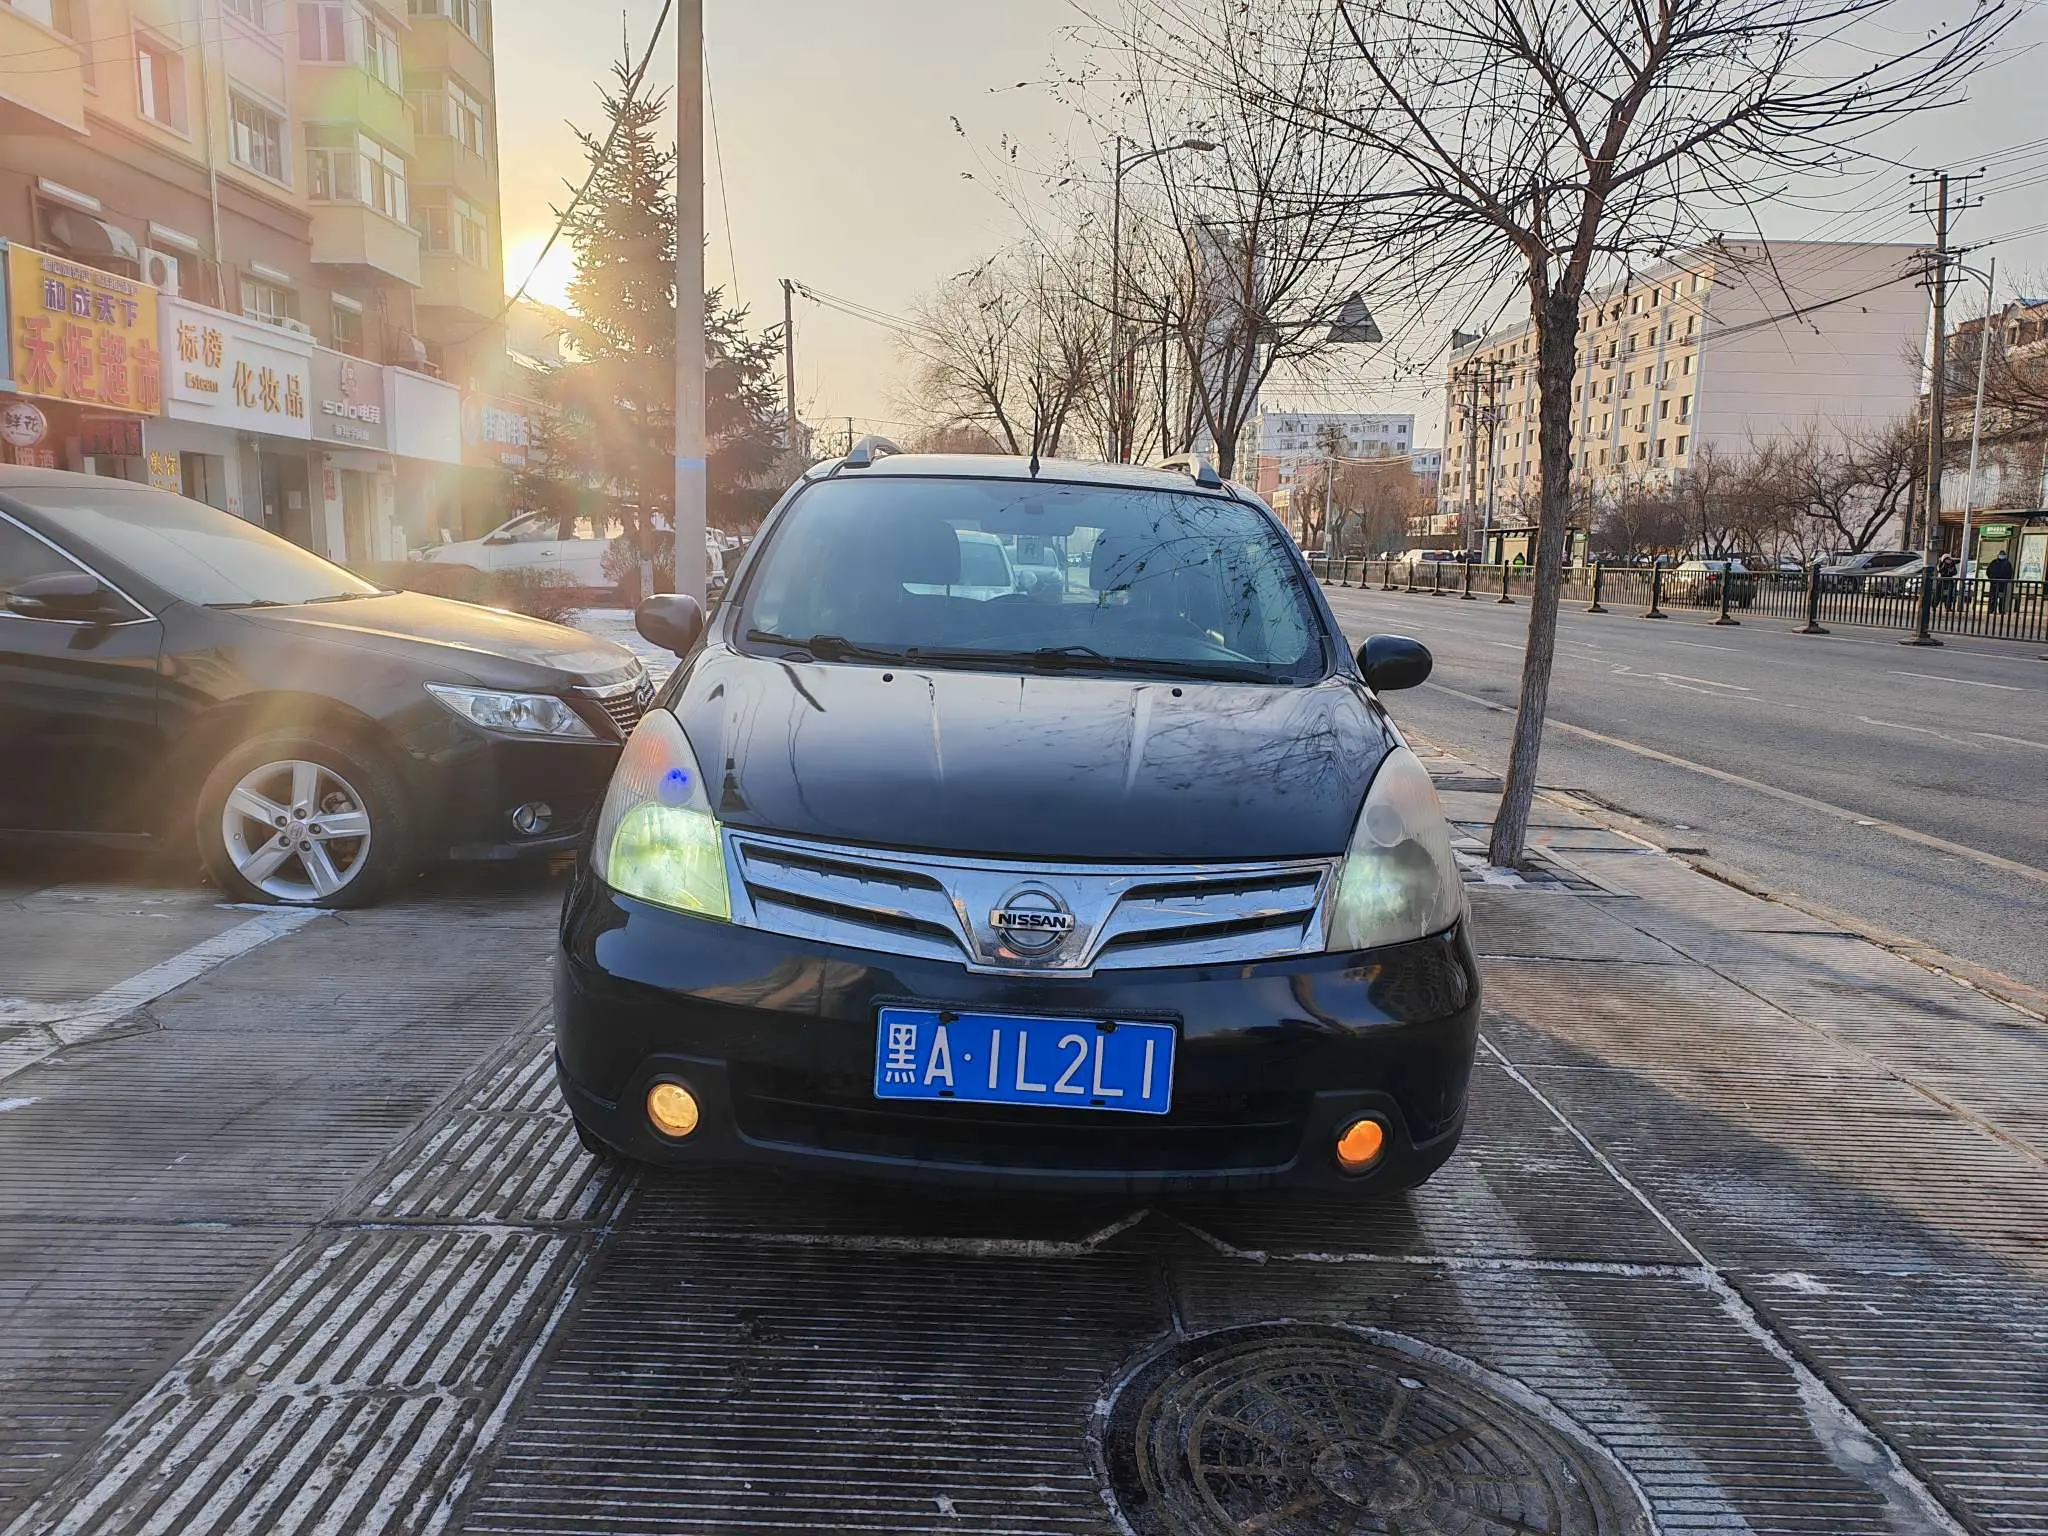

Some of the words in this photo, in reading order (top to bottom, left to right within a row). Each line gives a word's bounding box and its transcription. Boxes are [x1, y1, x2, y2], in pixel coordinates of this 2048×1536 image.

[177, 320, 223, 368] 标榜
[232, 360, 304, 419] 化妆品
[998, 912, 1067, 930] NISSAN
